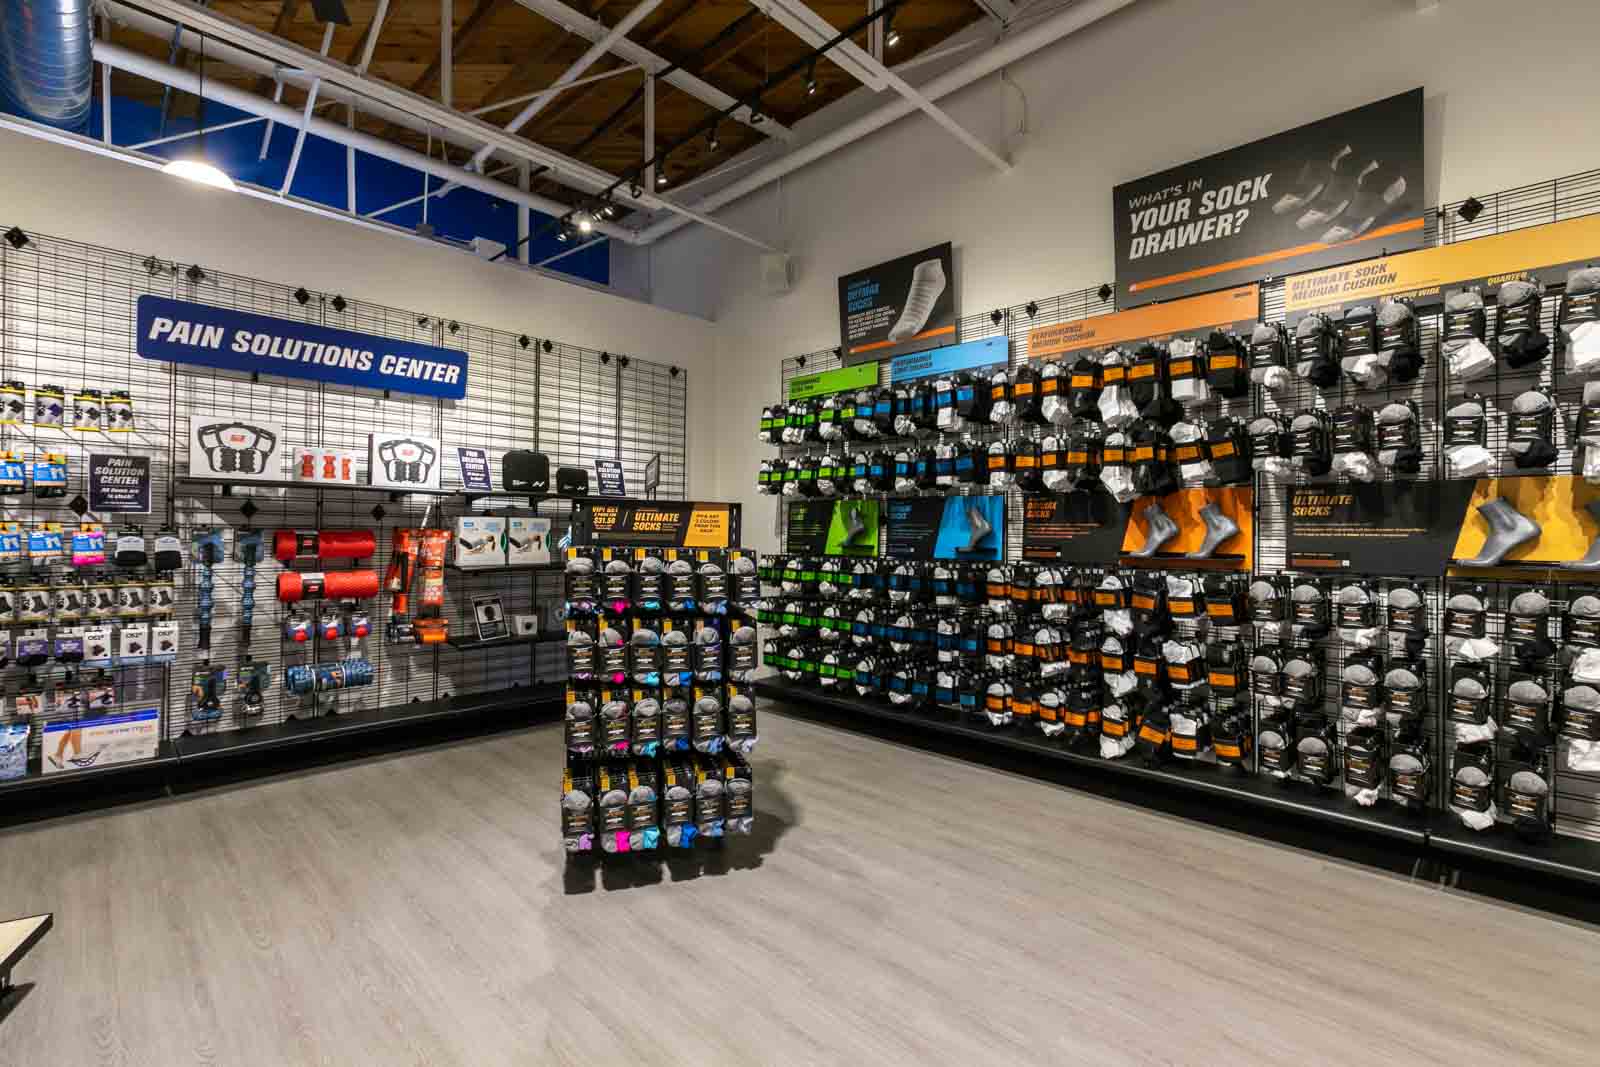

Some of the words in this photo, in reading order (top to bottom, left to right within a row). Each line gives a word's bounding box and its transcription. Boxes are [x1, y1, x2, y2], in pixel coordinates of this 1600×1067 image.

[1129, 184, 1183, 208] WHAT'S
[1187, 178, 1202, 192] IN
[1130, 198, 1191, 234] YOUR
[1198, 173, 1272, 215] SOCK
[1129, 208, 1249, 260] DRAWER?
[1292, 269, 1351, 291] ULTIMATE
[1354, 263, 1387, 278] SOCK
[1292, 286, 1339, 302] MEDIUM
[1343, 272, 1398, 292] CUSHION
[148, 317, 225, 349] PAIN
[231, 330, 374, 372] SOLUTIONS
[379, 355, 461, 385] CENTER
[108, 458, 132, 467] PAIN
[94, 466, 145, 476] SOLUTION
[100, 475, 140, 485] CENTER
[1292, 495, 1353, 505] ULTIMATE
[1293, 506, 1331, 516] SOCKS
[634, 512, 680, 523] ULTIMATE
[632, 522, 661, 531] SOCKS
